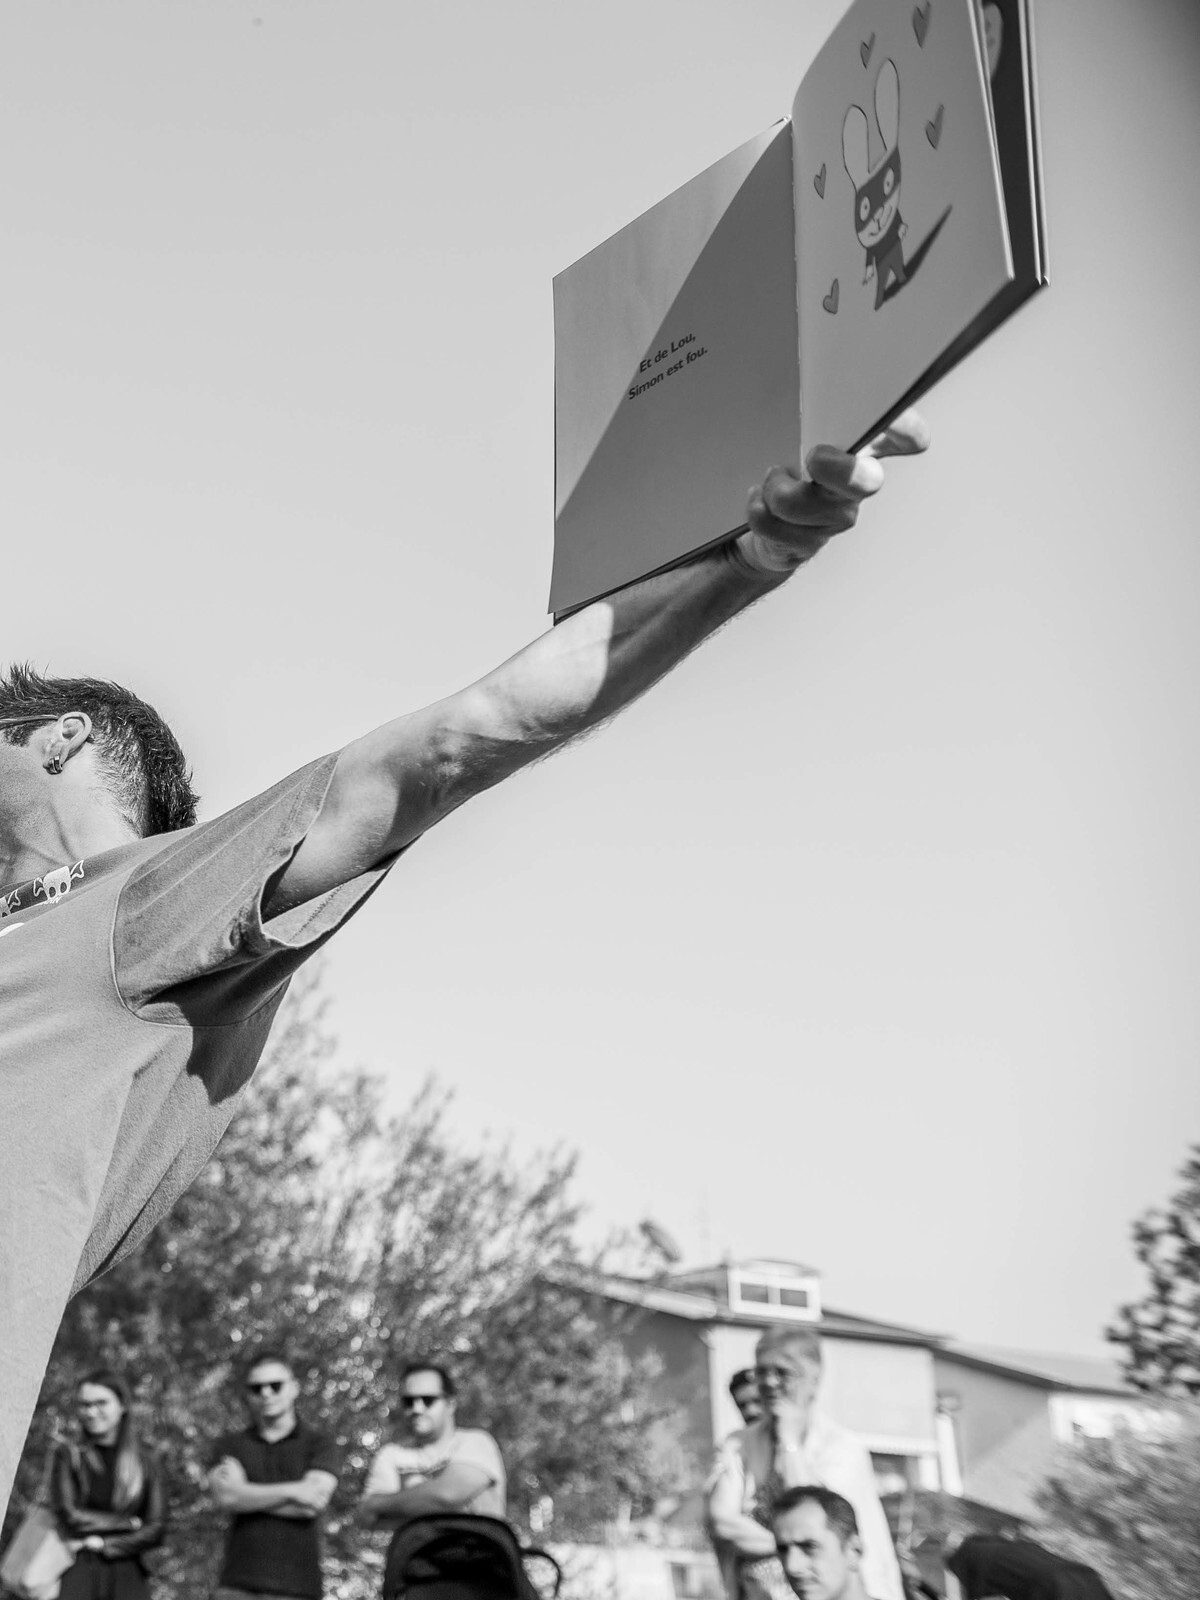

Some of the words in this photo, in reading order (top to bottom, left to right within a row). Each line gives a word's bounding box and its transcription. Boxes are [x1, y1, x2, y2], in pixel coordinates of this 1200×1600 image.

[628, 372, 664, 400] Simon
[666, 359, 684, 376] est
[686, 346, 708, 365] fou.
[639, 359, 652, 373] Et
[654, 350, 668, 363] de
[670, 333, 696, 353] Lou,
